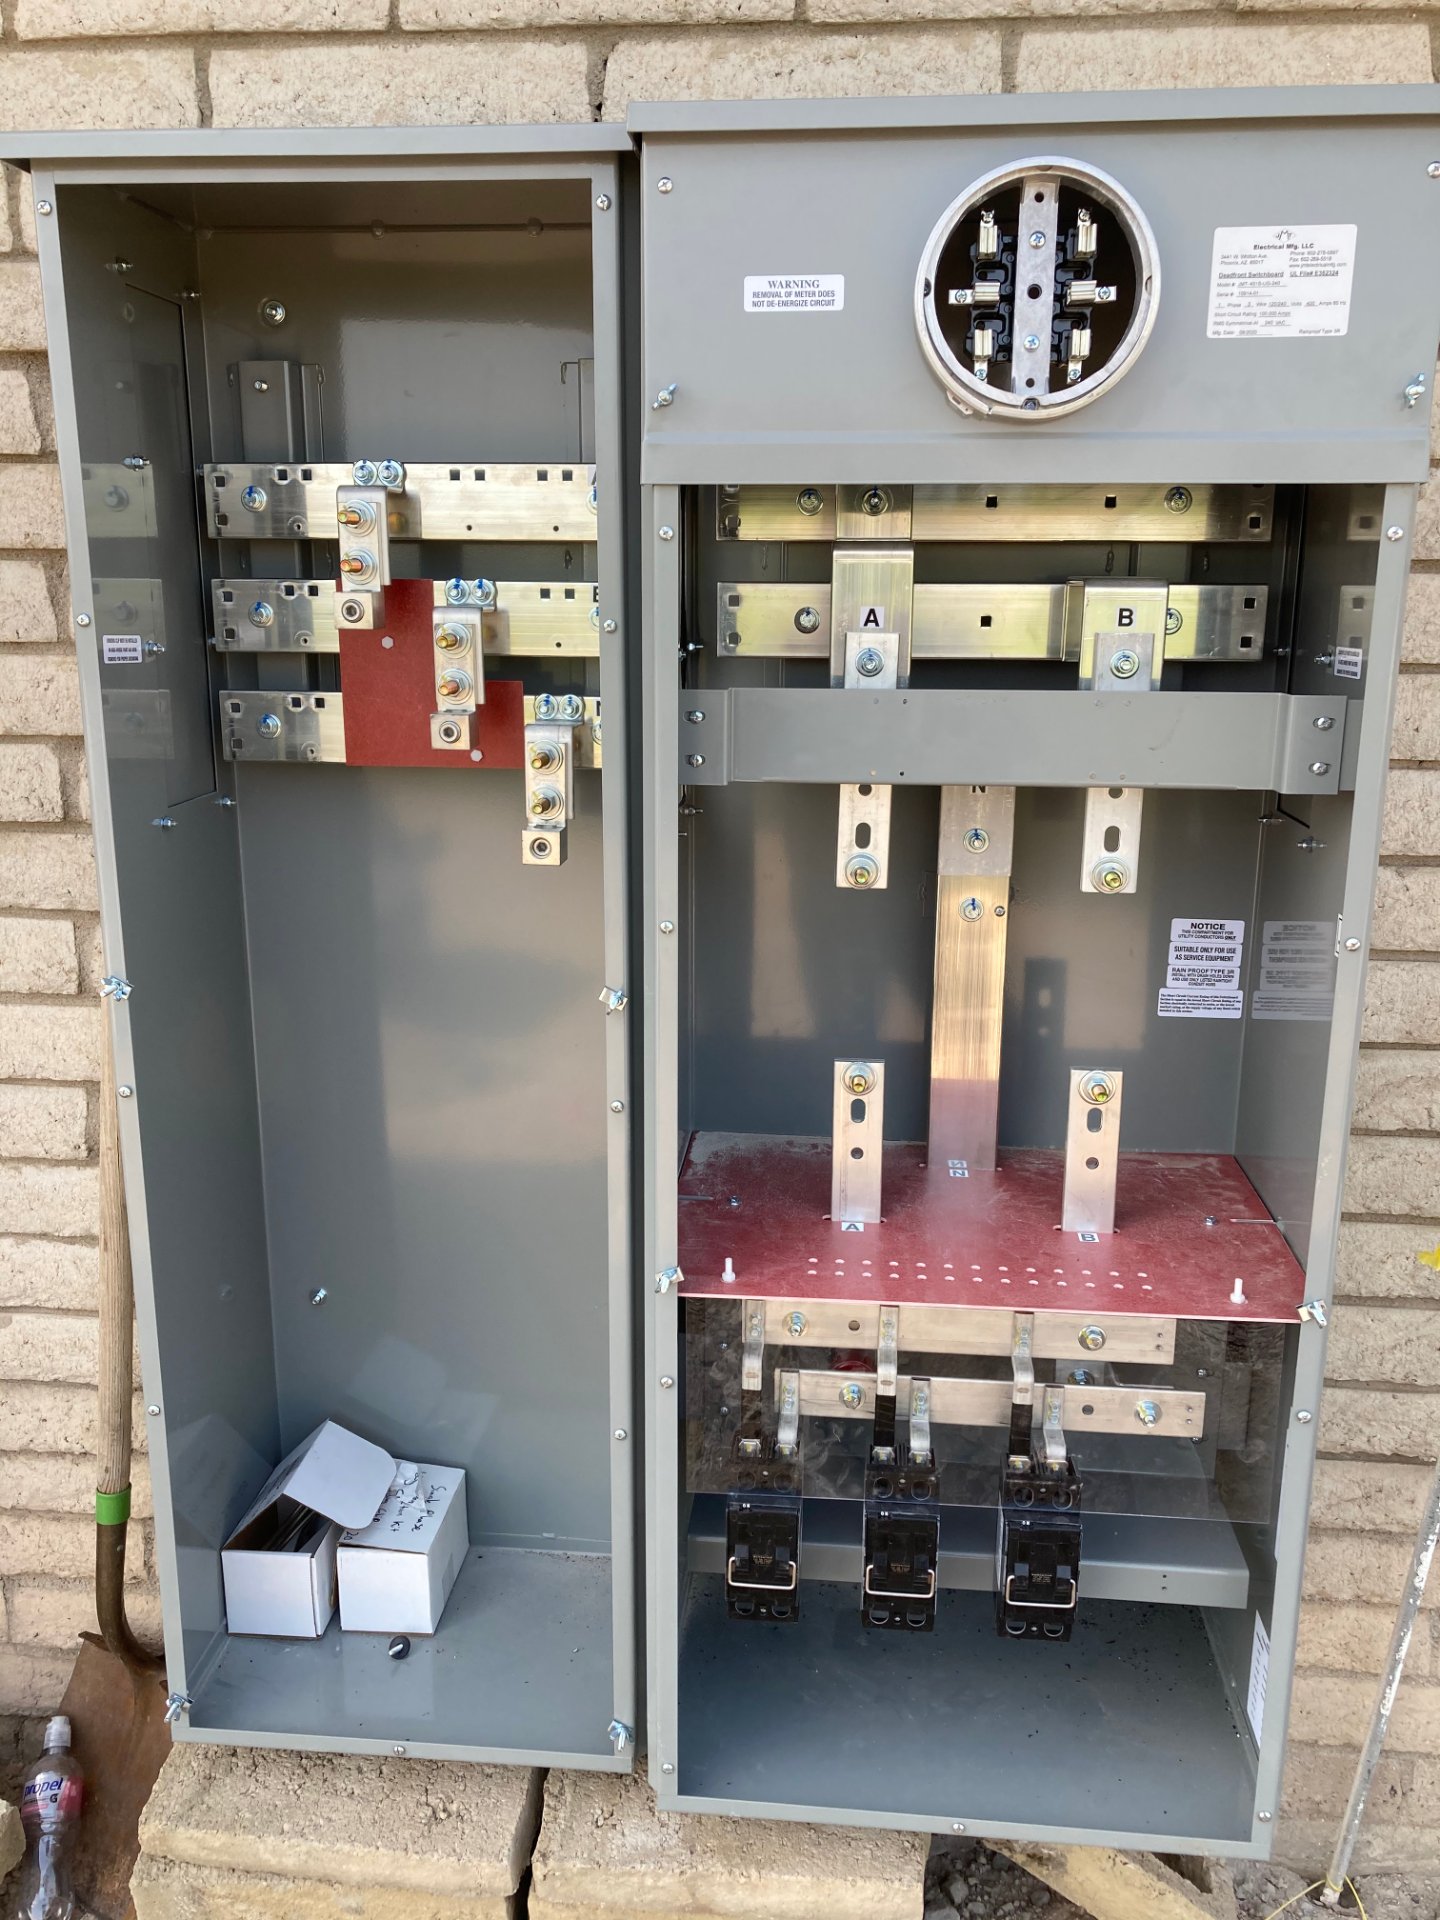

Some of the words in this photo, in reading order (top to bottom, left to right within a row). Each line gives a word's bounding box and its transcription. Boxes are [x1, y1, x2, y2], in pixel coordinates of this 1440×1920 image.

[768, 280, 820, 289] WARNING
[863, 608, 880, 627] A
[1118, 608, 1134, 627] B
[24, 1777, 63, 1798] propel
